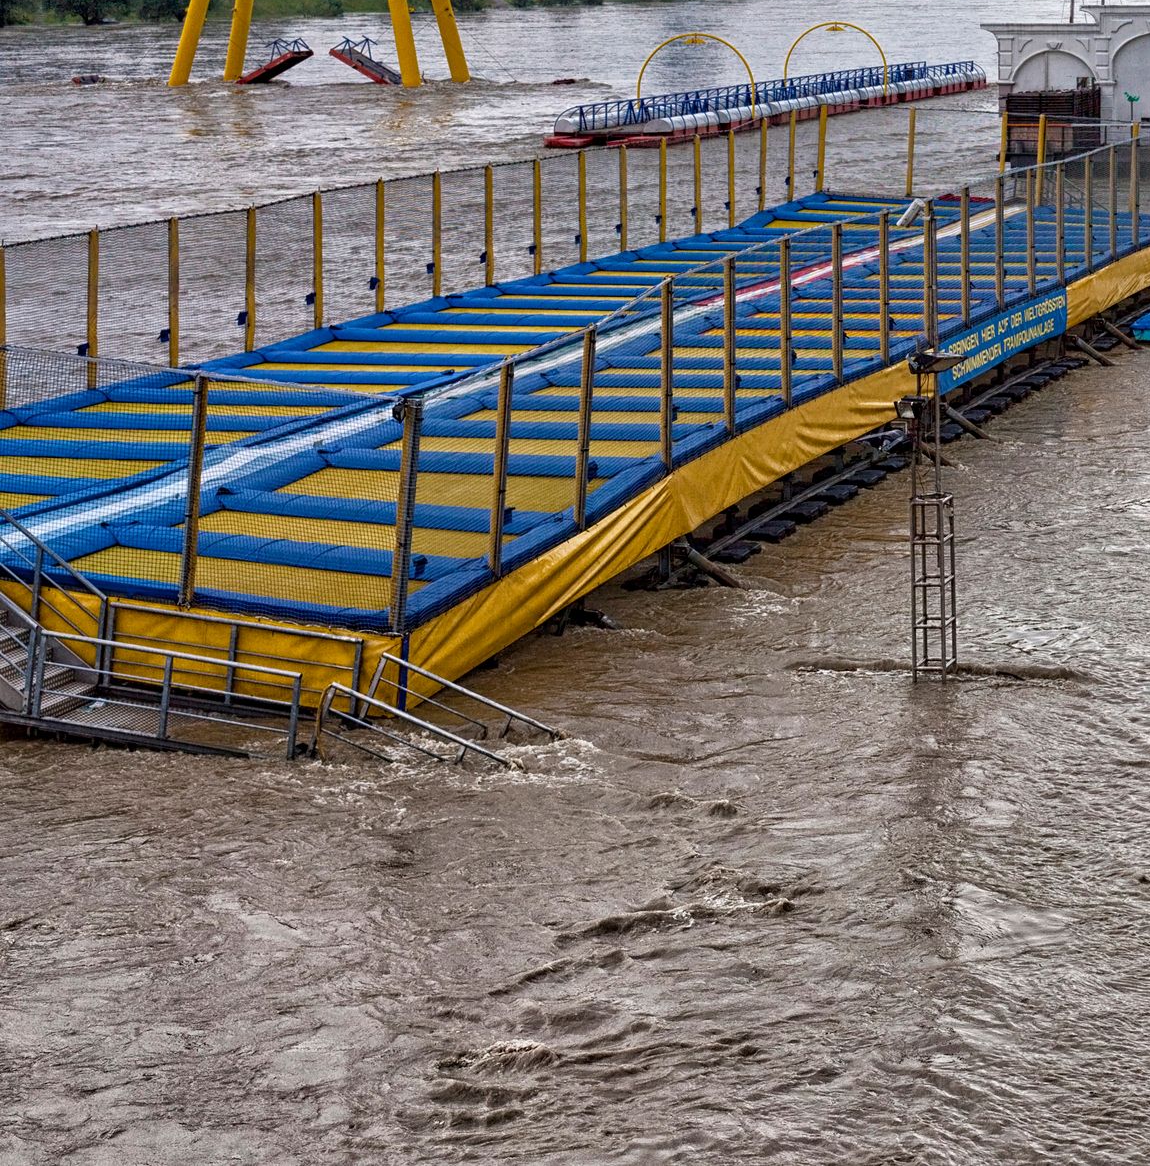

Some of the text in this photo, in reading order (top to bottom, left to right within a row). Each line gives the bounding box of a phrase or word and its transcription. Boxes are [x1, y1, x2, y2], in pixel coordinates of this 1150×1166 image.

[948, 332, 979, 355] SPRINGEN
[981, 324, 996, 343] HIER
[998, 316, 1009, 335] AUF
[1010, 312, 1022, 329] DER
